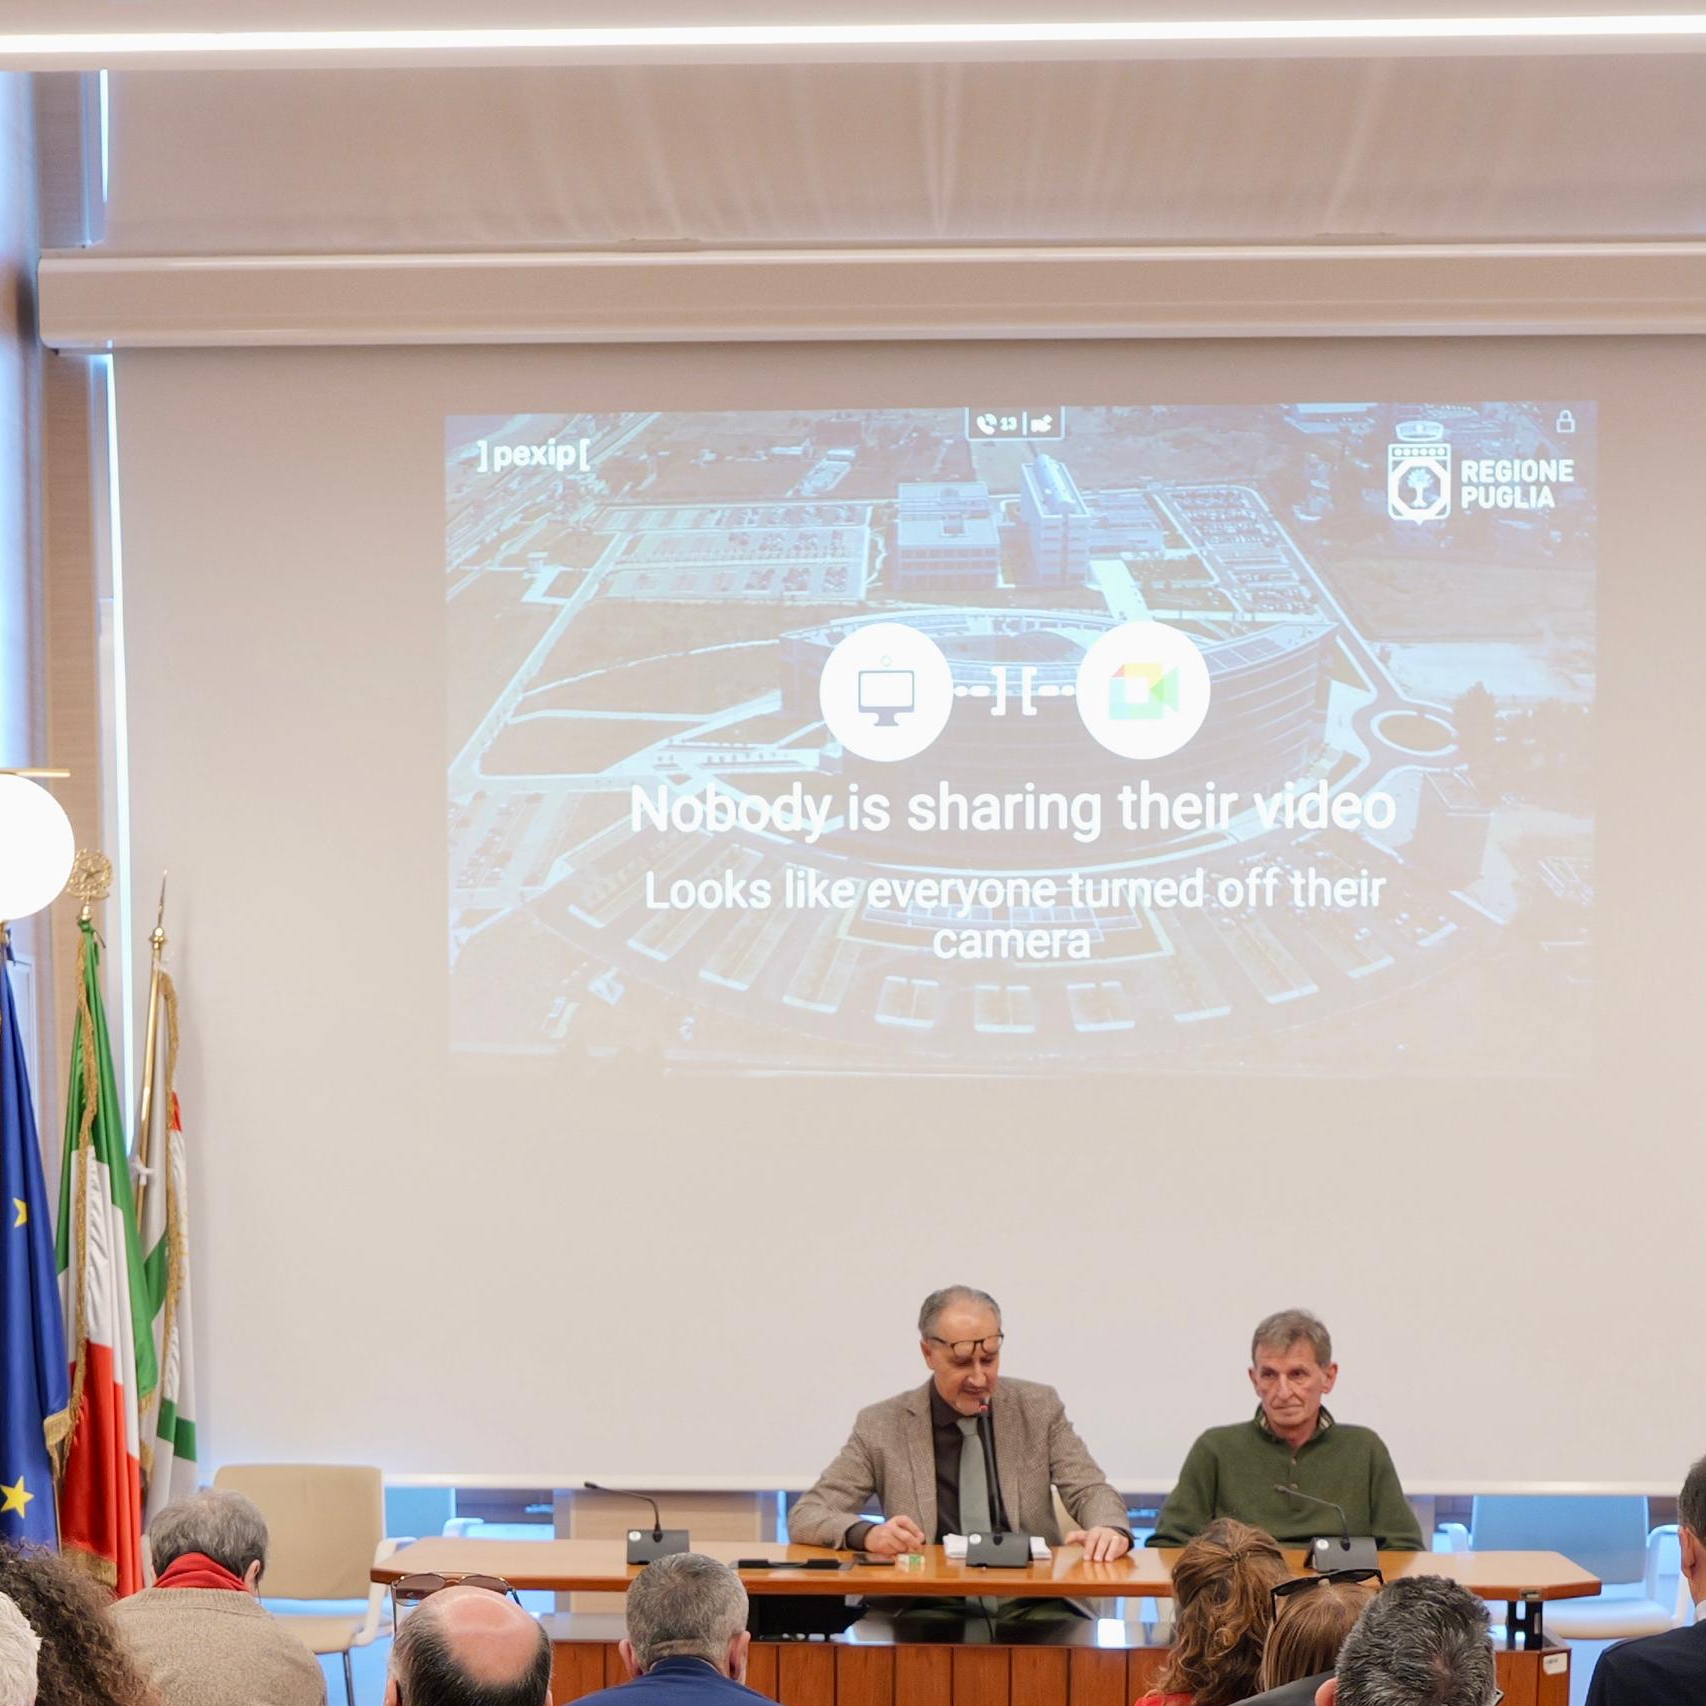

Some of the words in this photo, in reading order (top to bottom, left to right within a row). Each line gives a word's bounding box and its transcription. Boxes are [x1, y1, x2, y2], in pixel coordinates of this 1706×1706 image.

[1461, 459, 1575, 483] REGIONE
[1461, 486, 1556, 509] PUGLIA
[631, 781, 833, 843] Nobody
[848, 783, 891, 831] is
[907, 780, 1102, 843] sharing
[1117, 779, 1239, 830] their
[1252, 779, 1397, 830] video
[645, 869, 771, 909] Looks
[785, 868, 855, 909] like
[867, 876, 1056, 918] everyone
[1068, 867, 1204, 908] turned
[1218, 867, 1282, 908] off
[1292, 867, 1387, 907] their
[933, 927, 1091, 959] camera
